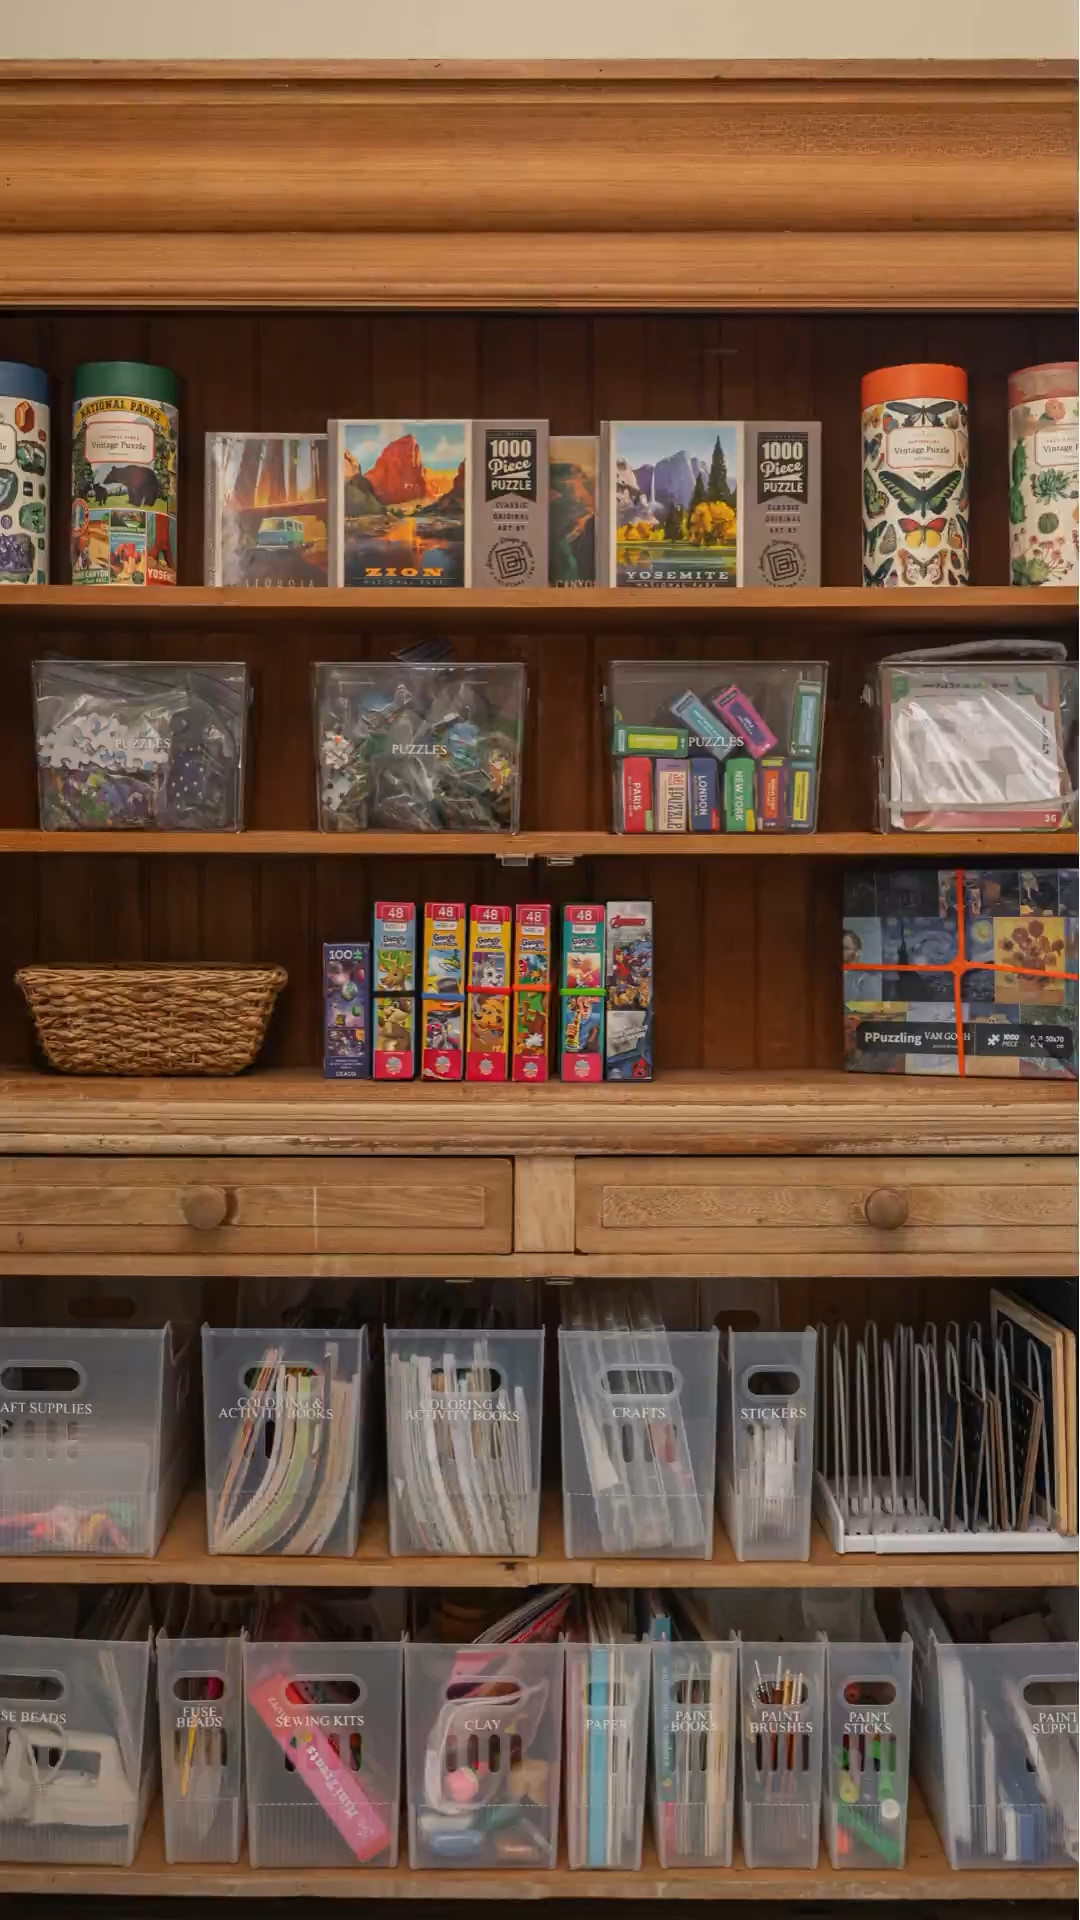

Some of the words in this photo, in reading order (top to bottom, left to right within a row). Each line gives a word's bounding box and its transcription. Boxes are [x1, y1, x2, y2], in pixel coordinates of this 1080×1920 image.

[80, 400, 124, 418] NATIONAL
[131, 402, 160, 420] PARKS
[489, 439, 531, 458] 1000
[761, 441, 803, 460] 1000
[894, 446, 925, 455] Vintage
[926, 445, 950, 454] Puzzle
[1042, 444, 1073, 453] Vintage
[488, 458, 532, 475] Piece
[760, 460, 803, 478] Piece
[491, 480, 532, 490] PUZZLE
[763, 482, 804, 493] PUZZLE
[365, 567, 443, 577] ZION
[625, 571, 729, 580] YOSEMITE
[688, 736, 745, 747] PUZZLES
[391, 744, 448, 755] PUZZLES
[735, 770, 745, 793] NEW
[632, 782, 642, 811] PARIS
[698, 775, 709, 816] LONDON
[667, 791, 685, 829] PUZZLE
[734, 794, 745, 821] YORK
[387, 907, 404, 919] 48
[438, 906, 454, 917] 48
[483, 909, 498, 920] 48
[526, 911, 542, 922] 48
[576, 910, 593, 921] 48
[329, 949, 353, 960] 100
[864, 1031, 923, 1046] PPuzzling
[924, 1031, 943, 1041] VAN
[943, 1032, 971, 1042] GOH
[0, 1402, 27, 1413] AFT
[29, 1402, 93, 1415] SUPPLIES
[311, 1397, 322, 1409] &
[421, 1399, 493, 1410] OLORING
[287, 1408, 333, 1420] BOOKS
[473, 1410, 521, 1422] BOOKS
[612, 1407, 667, 1419] CRAFTS
[740, 1407, 808, 1420] STICKERS
[21, 1711, 66, 1724] BEADS
[183, 1706, 217, 1717] FUSE
[675, 1710, 713, 1721] PAINT
[761, 1711, 801, 1722] PAINT
[849, 1711, 890, 1723] PAINT
[175, 1716, 224, 1728] BEADS
[275, 1715, 330, 1728] SEWING
[333, 1715, 365, 1726] KITS
[463, 1719, 501, 1731] CLAY
[584, 1719, 628, 1730] PAPER
[671, 1721, 717, 1732] BOOKS
[750, 1721, 813, 1733] BRUSHES
[844, 1722, 892, 1734] STICKS
